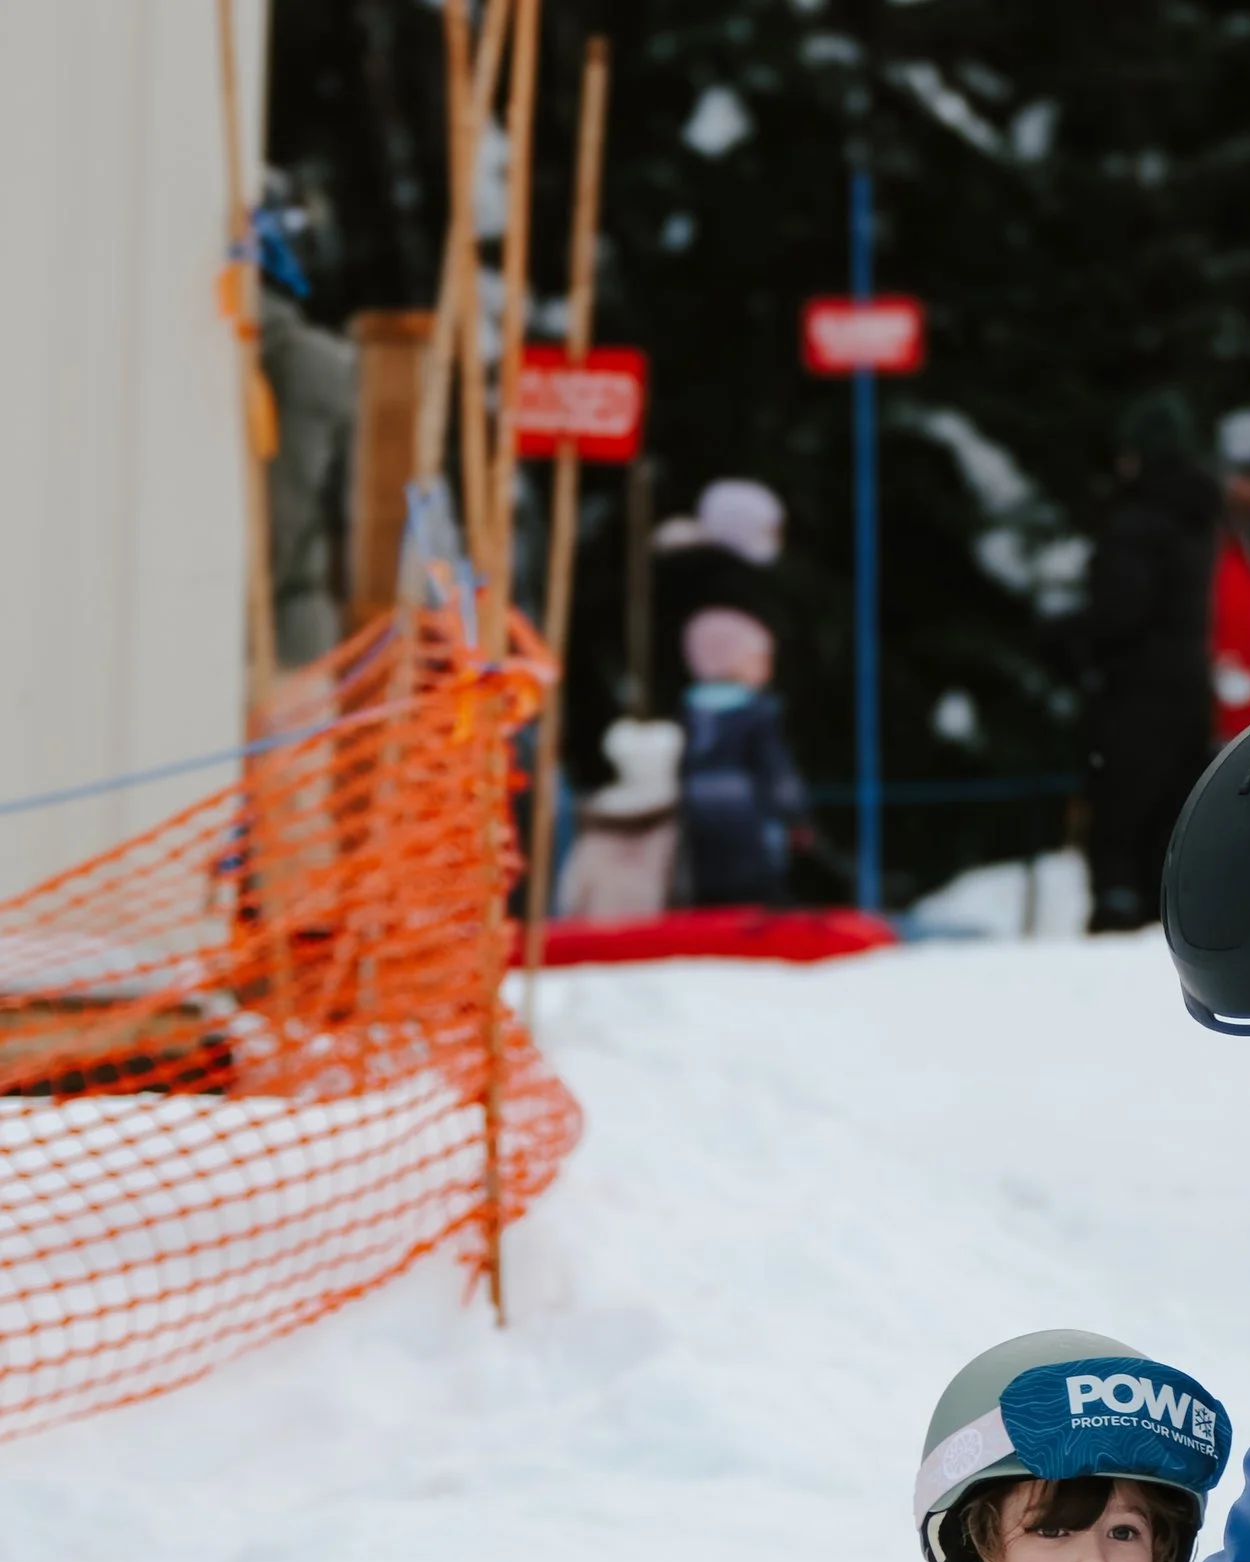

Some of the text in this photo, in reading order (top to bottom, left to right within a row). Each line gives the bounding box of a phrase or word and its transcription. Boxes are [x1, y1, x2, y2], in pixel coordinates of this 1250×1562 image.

[1065, 1373, 1191, 1429] POW
[1071, 1415, 1139, 1429] PROTECT
[1141, 1419, 1170, 1438] OUR
